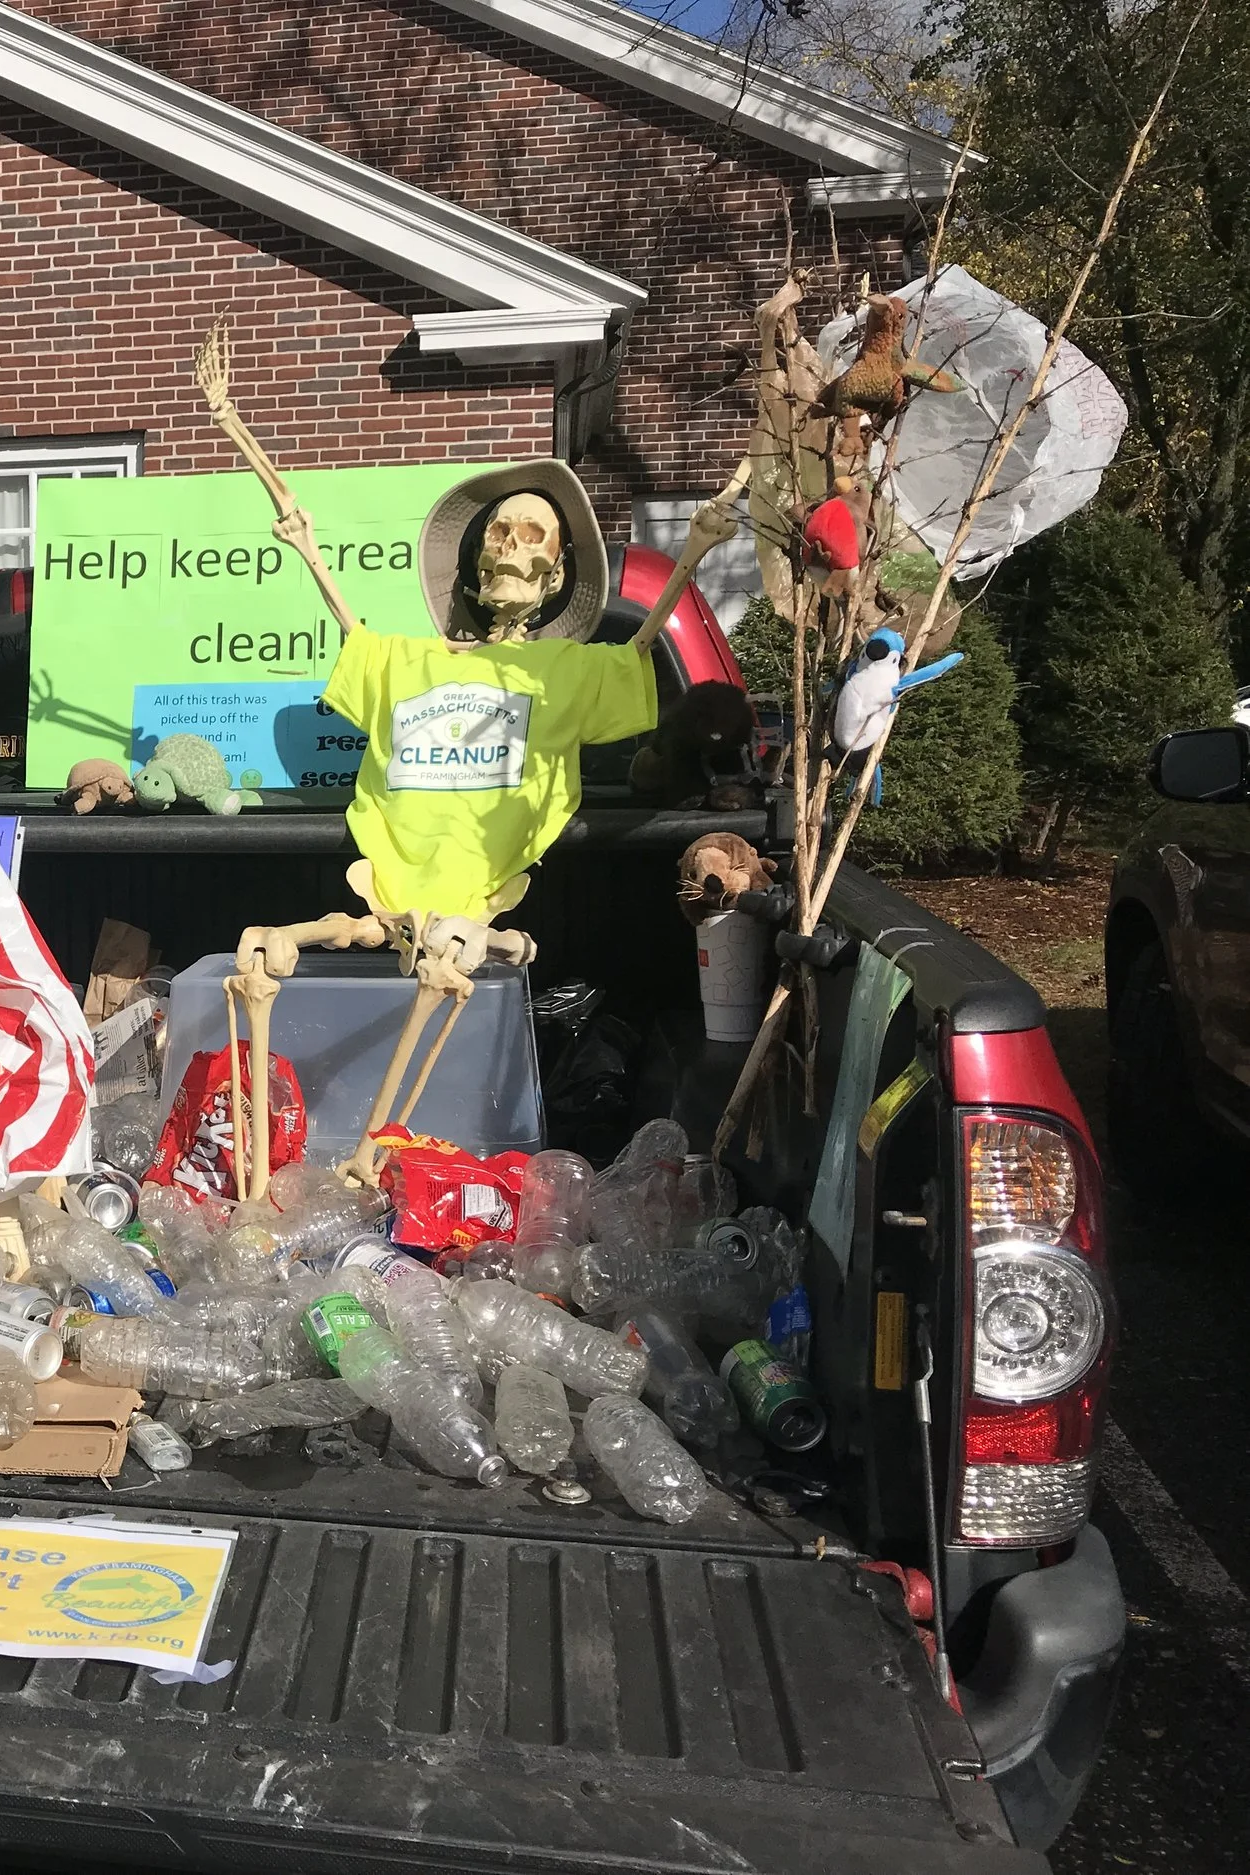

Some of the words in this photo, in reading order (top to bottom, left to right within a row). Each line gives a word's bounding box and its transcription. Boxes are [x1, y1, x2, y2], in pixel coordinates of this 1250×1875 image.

[43, 540, 148, 589] Help
[171, 539, 282, 584] keep
[318, 541, 413, 572] rea
[190, 619, 327, 664] clean!
[154, 696, 169, 706] All
[171, 695, 186, 706] of
[188, 694, 207, 705] this
[211, 694, 241, 705] trash
[244, 697, 267, 705] was
[443, 693, 477, 702] GREAT
[161, 713, 197, 726] picked
[201, 716, 217, 726] up
[220, 713, 237, 724] off
[239, 713, 259, 723] the
[401, 702, 519, 730] MASSACHUSETTS
[226, 732, 237, 742] in
[400, 745, 510, 765] CLEANUP
[300, 770, 358, 788] sca
[420, 772, 487, 781] FRAMINGHAM
[334, 1314, 356, 1325] ALE
[103, 1561, 187, 1585] FRAMINGHAM
[41, 1592, 203, 1618] Beautiful
[27, 1628, 185, 1649] www.k-f-b.org
